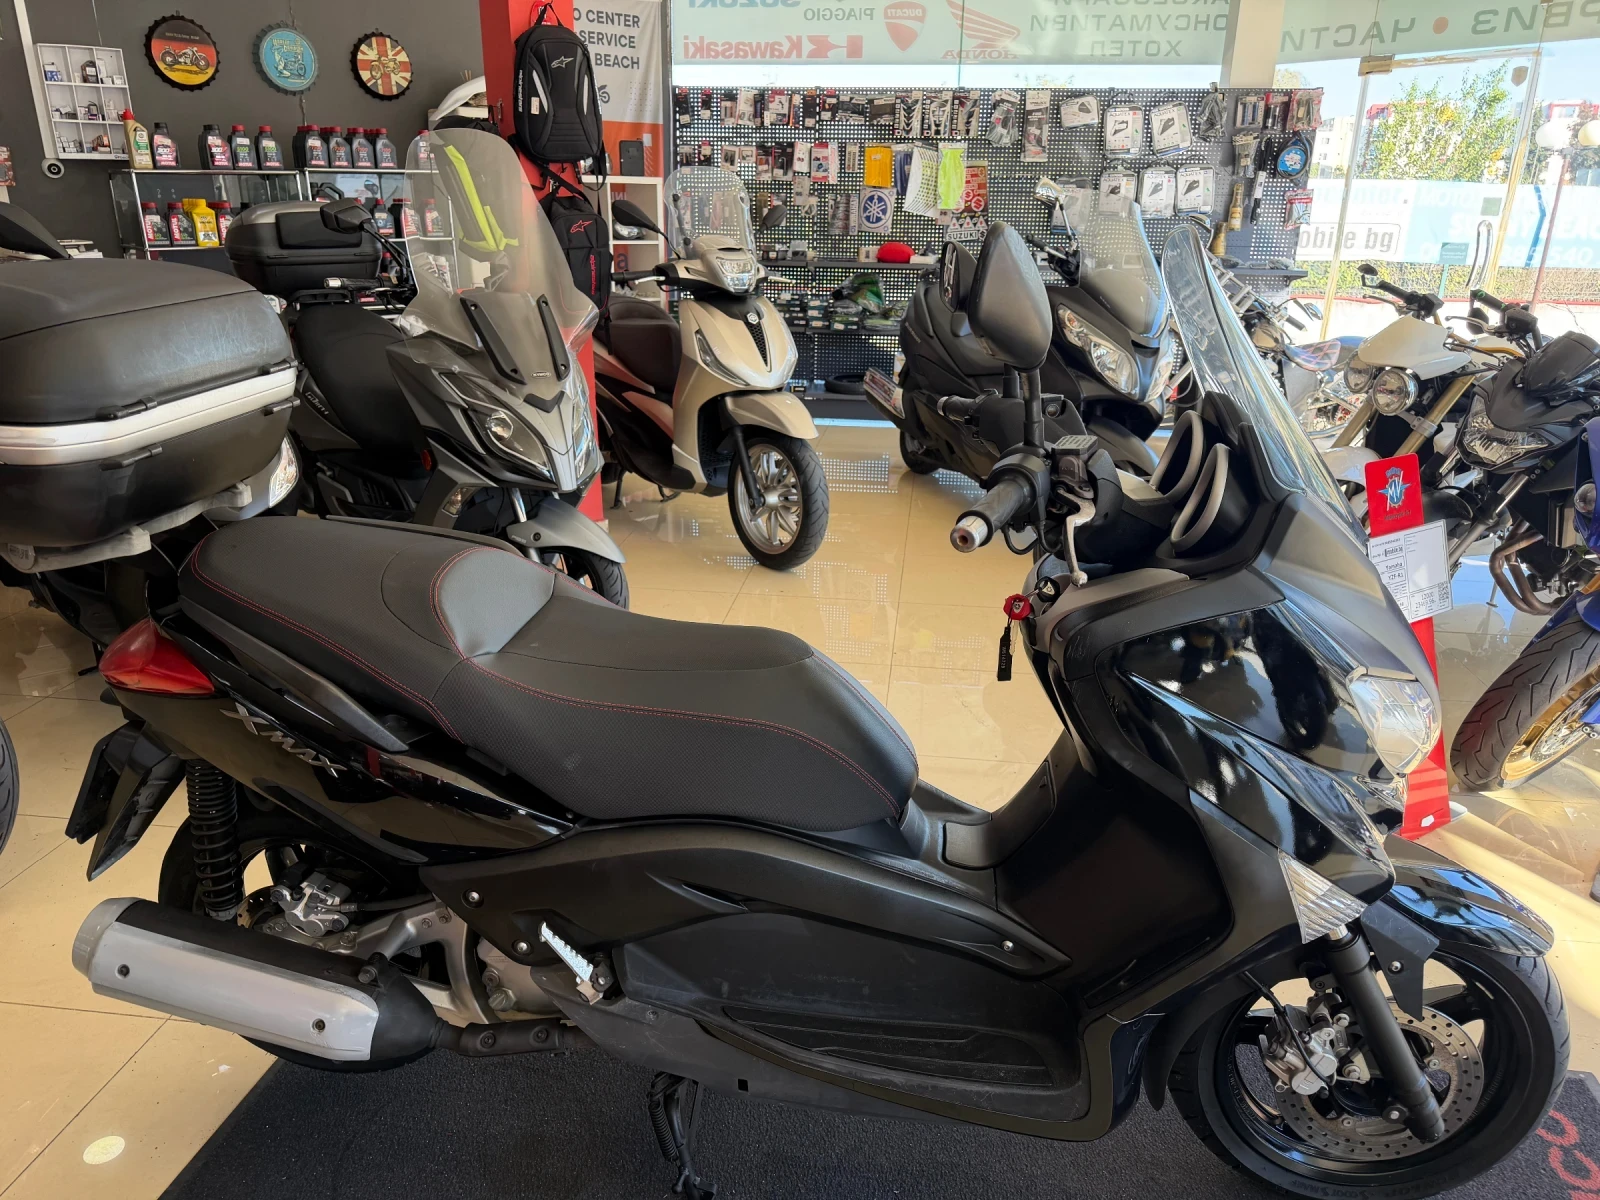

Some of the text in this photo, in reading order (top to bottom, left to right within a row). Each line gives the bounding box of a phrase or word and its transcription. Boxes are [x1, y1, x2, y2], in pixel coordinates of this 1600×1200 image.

[585, 9, 641, 29] CENTER
[578, 29, 637, 49] SERVICE
[594, 52, 641, 70] BEACH
[947, 232, 977, 241] SUZUKI
[1386, 562, 1403, 570] Yamaha
